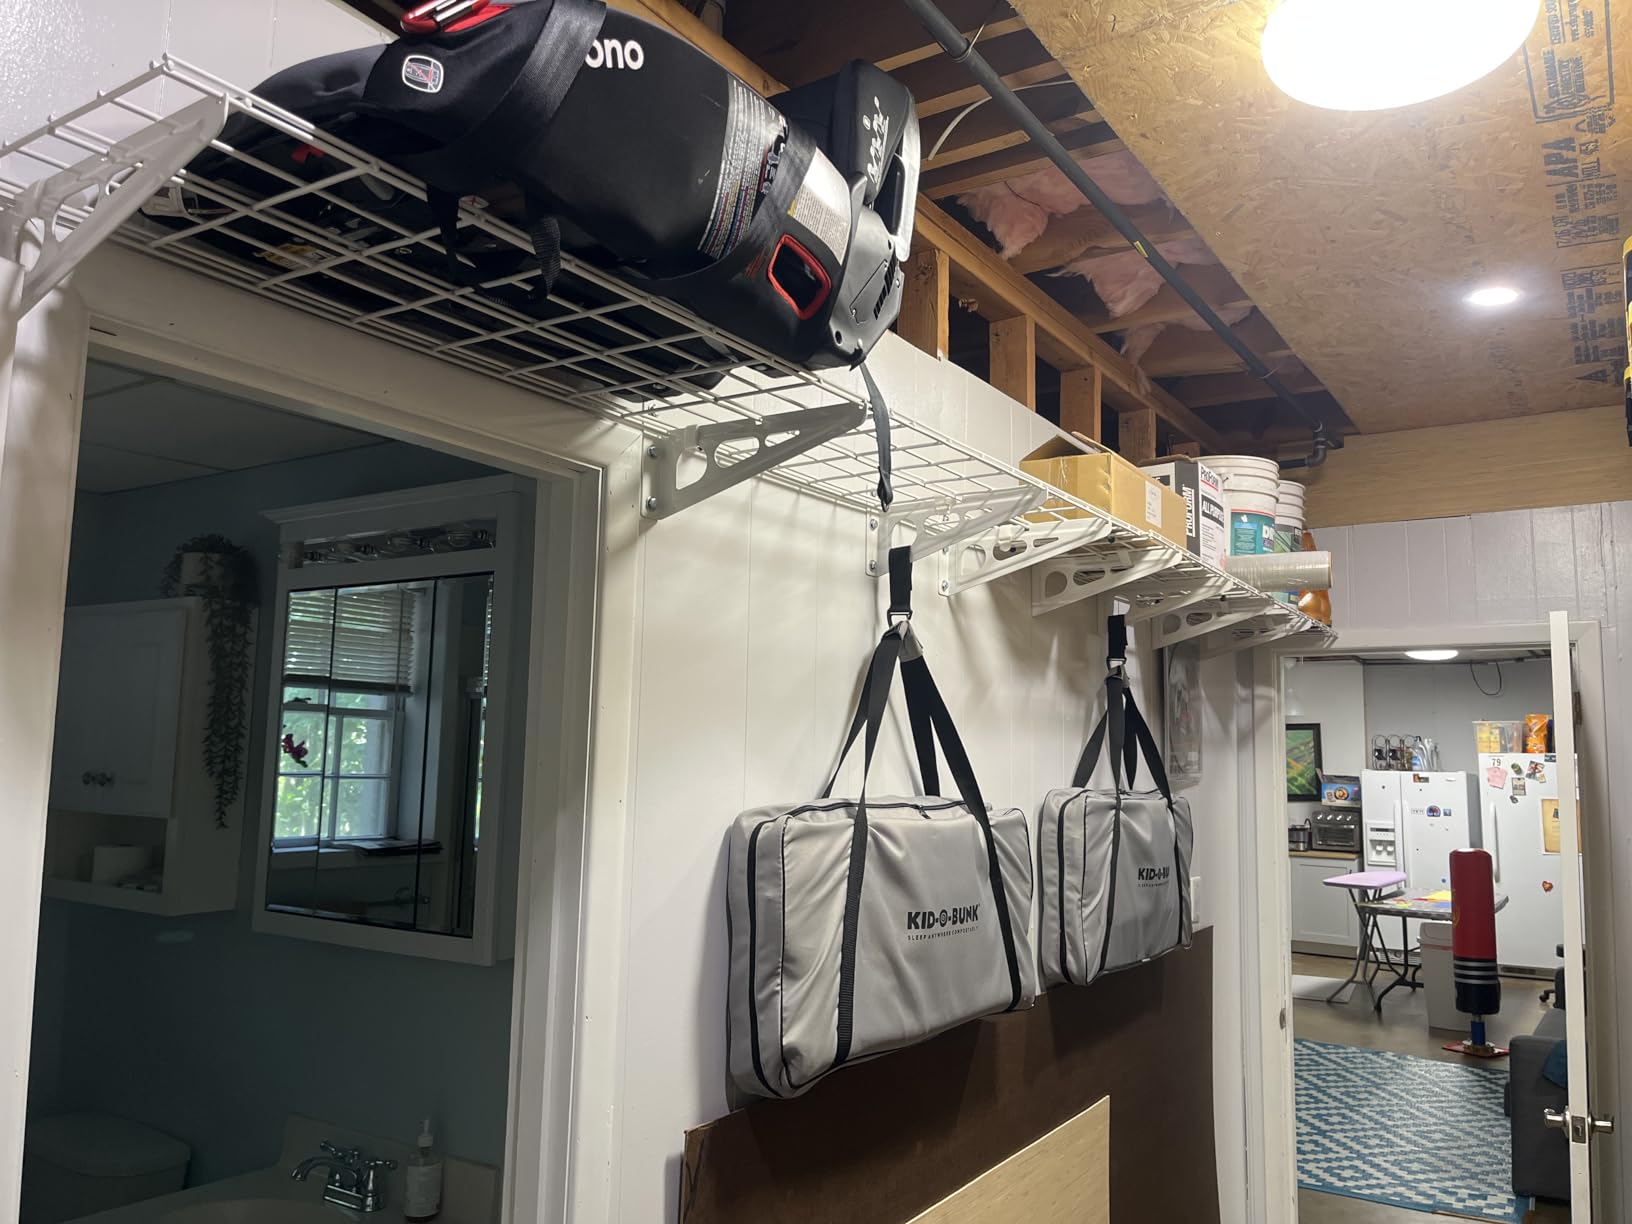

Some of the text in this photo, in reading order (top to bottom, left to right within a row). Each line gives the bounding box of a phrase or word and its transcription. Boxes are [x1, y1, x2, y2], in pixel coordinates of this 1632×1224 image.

[584, 38, 645, 70] ono
[1541, 137, 1578, 178] APA
[1202, 500, 1210, 514] ALL
[1492, 758, 1501, 767] 79
[907, 904, 979, 930] KID-O-BUNK
